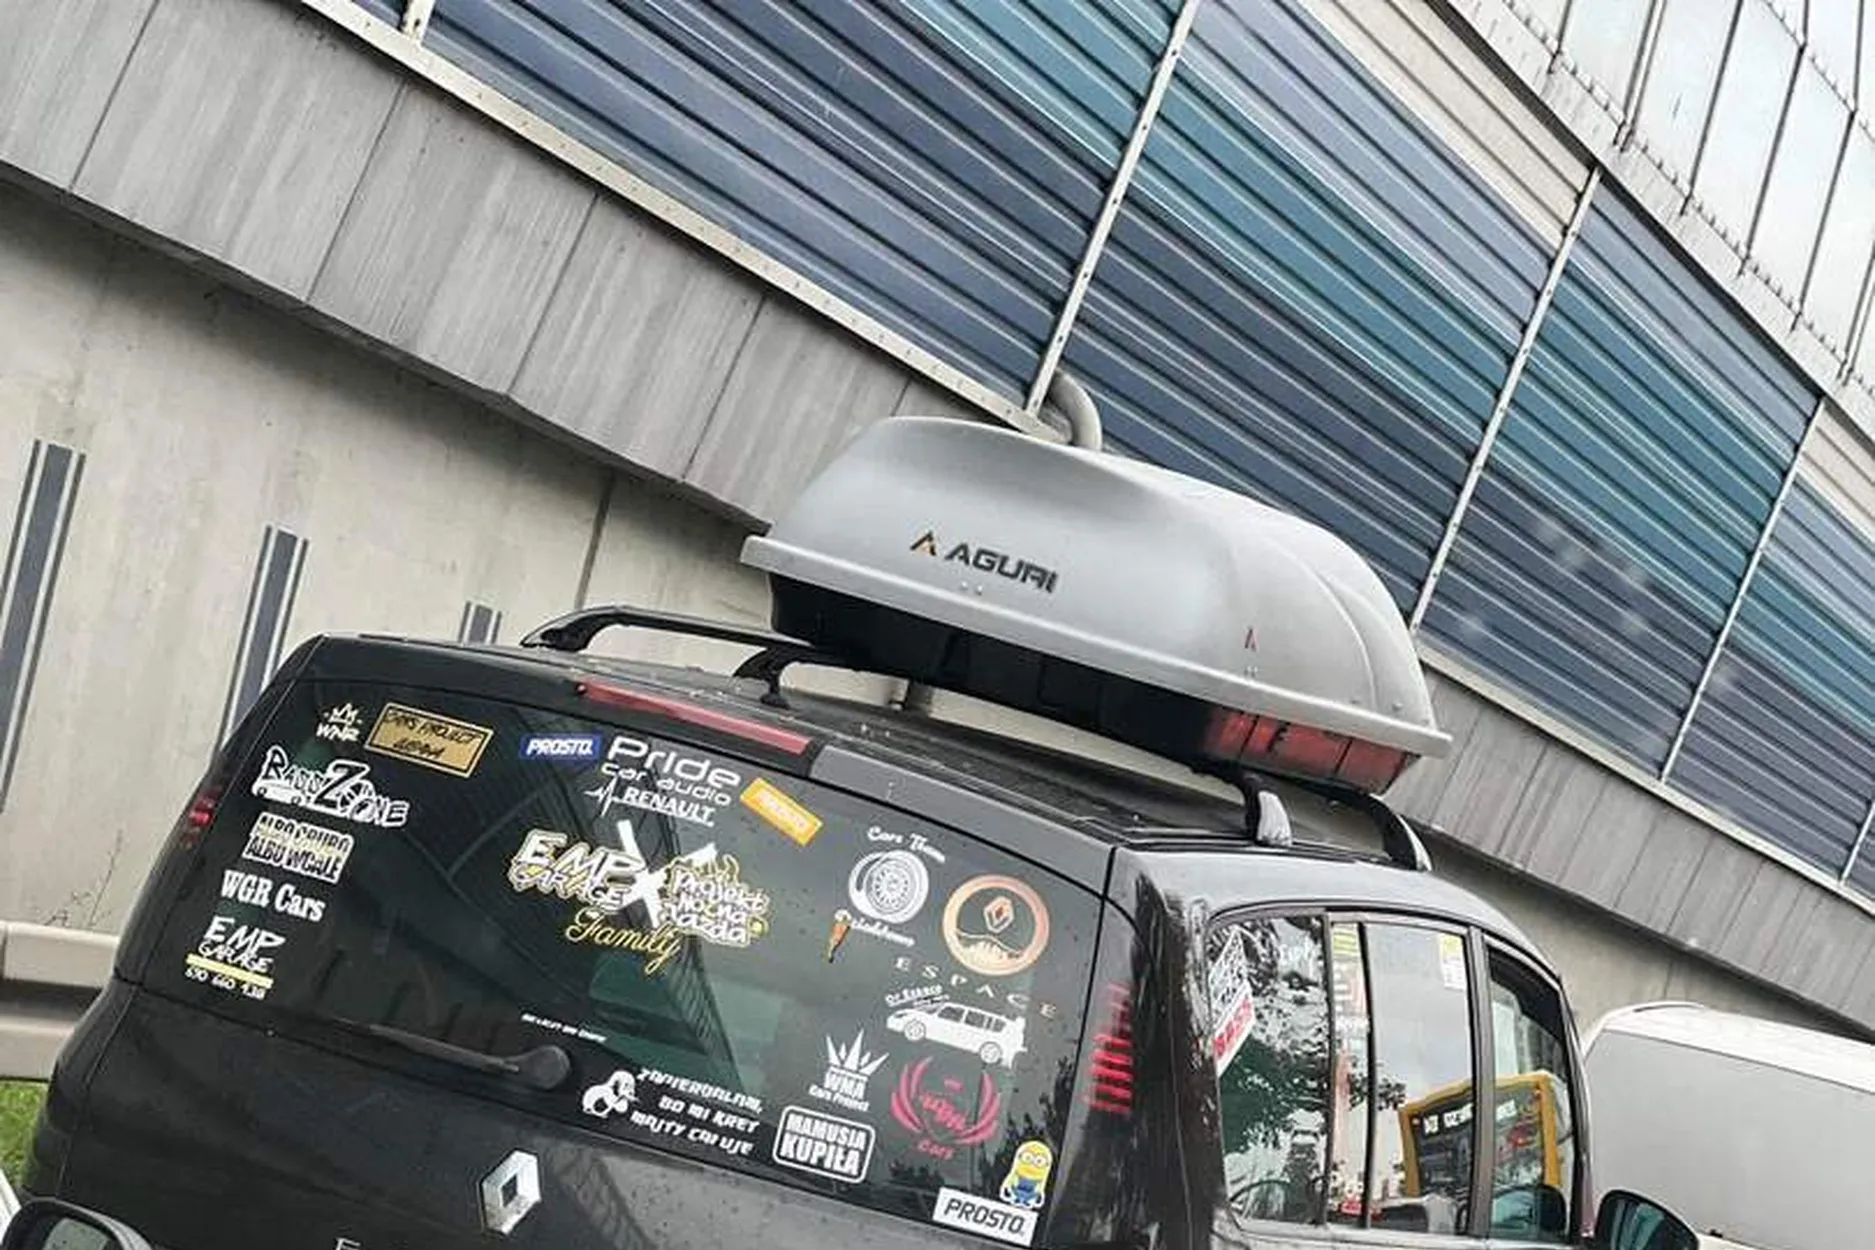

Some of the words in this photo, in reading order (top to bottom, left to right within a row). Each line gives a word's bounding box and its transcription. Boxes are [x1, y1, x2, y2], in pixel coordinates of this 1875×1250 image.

[943, 541, 1060, 594] AGURI
[607, 736, 741, 787] Pride
[601, 762, 647, 782] car
[656, 776, 732, 807] audio
[220, 870, 271, 908] WGR
[275, 883, 326, 923] Cars
[198, 940, 273, 973] GARAGE
[203, 916, 286, 955] EMP
[565, 907, 684, 975] Family
[785, 1113, 868, 1151] MAMUSIA
[780, 1135, 862, 1177] KUPIŁA
